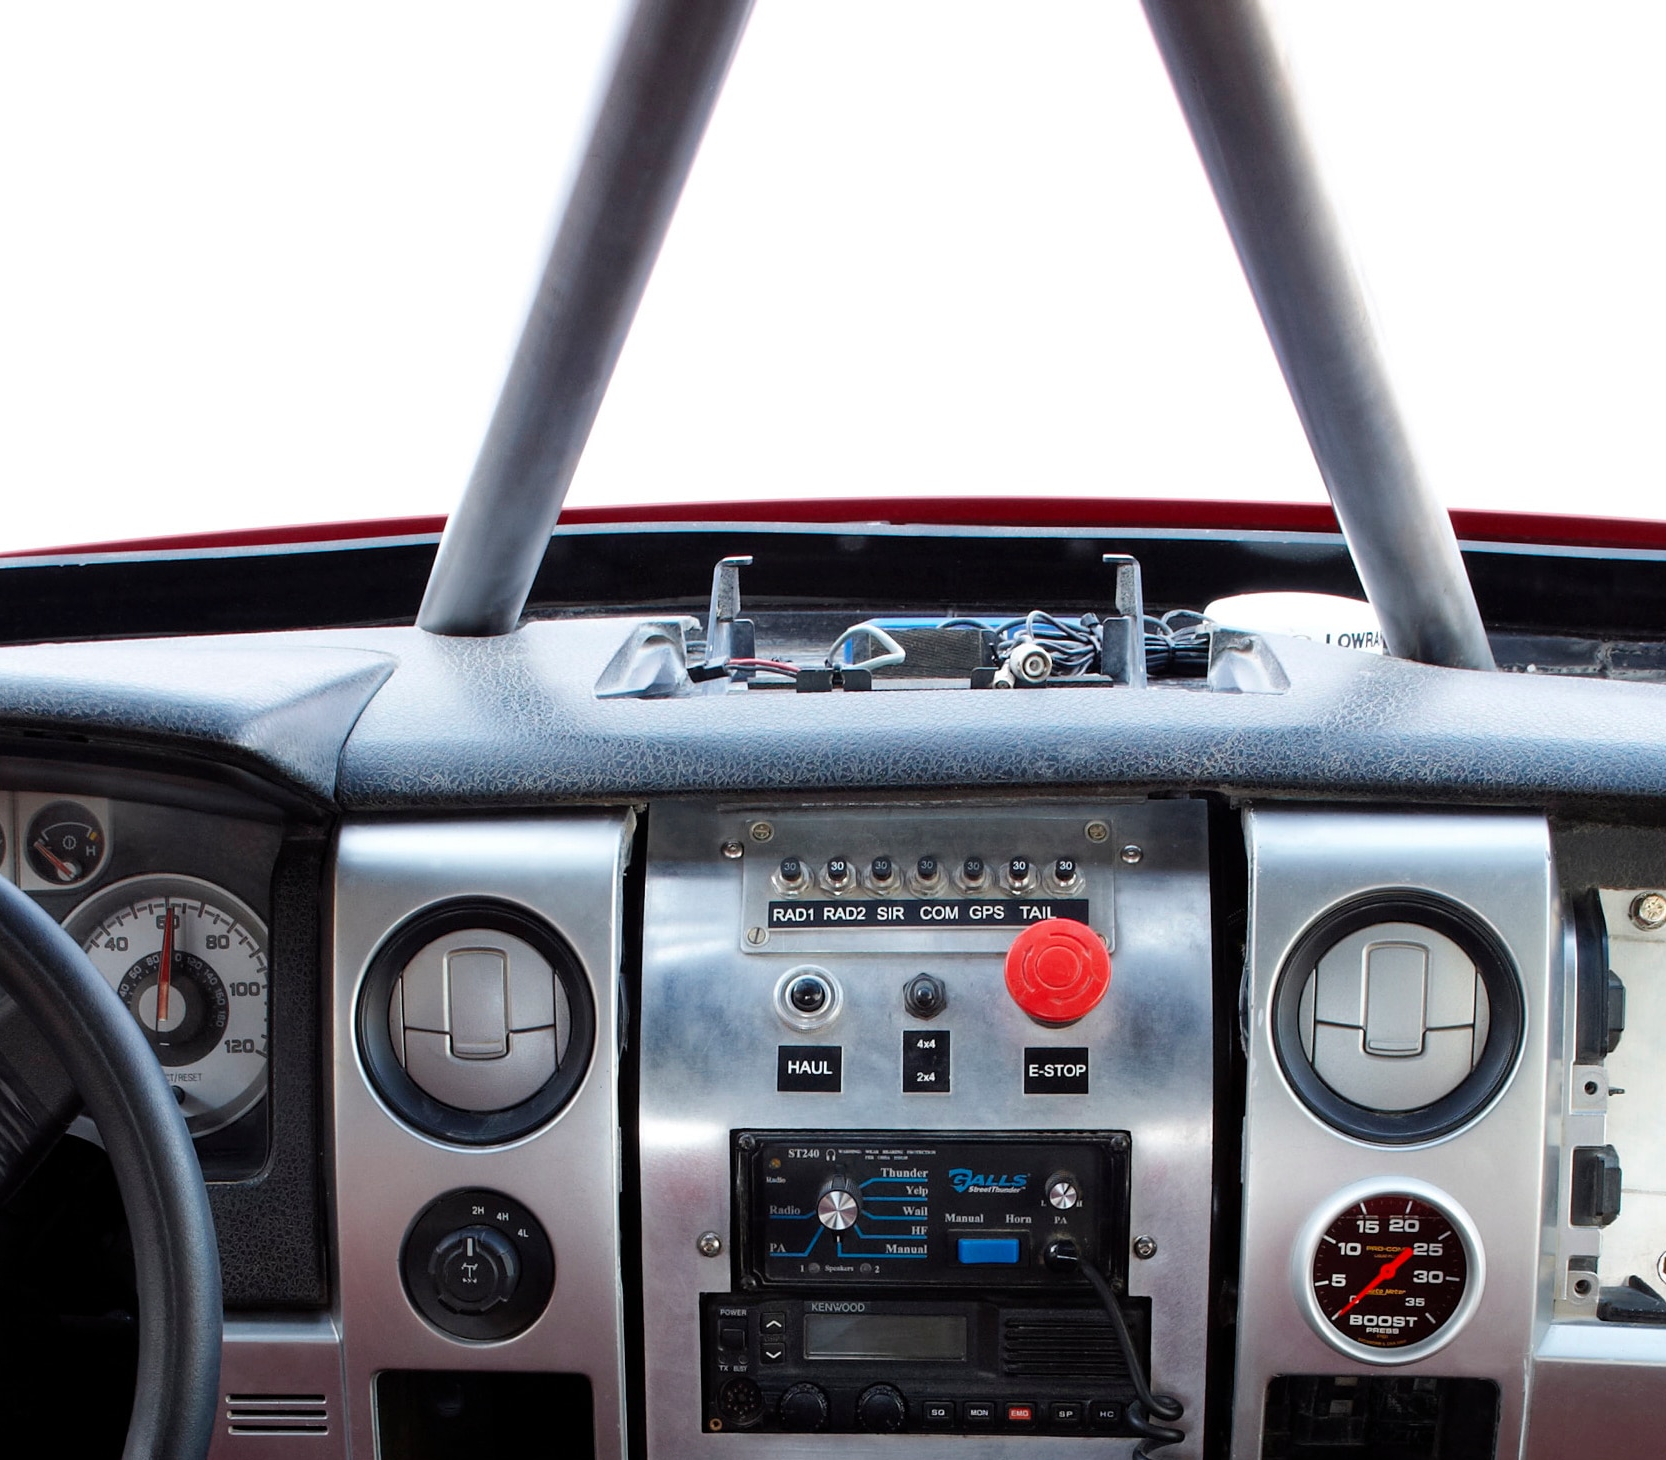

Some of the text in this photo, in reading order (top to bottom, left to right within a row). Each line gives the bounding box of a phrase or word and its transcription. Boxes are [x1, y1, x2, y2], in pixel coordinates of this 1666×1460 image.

[830, 861, 844, 871] 30
[1013, 861, 1026, 870] 30
[1059, 861, 1073, 870] 30
[773, 905, 1057, 922] RAD1 RAD2 SIR COM GPS TAIL
[104, 936, 129, 951] 40
[206, 934, 230, 950] 80
[229, 982, 260, 996] 100
[224, 1039, 255, 1053] 120
[917, 1039, 936, 1049] 4x4
[787, 1060, 833, 1075] HAUL
[1028, 1063, 1087, 1077] E-STOP
[917, 1072, 935, 1082] 2x4
[788, 1149, 820, 1158] ST240
[881, 1168, 929, 1178] Thunder
[906, 1185, 929, 1197] Yelp
[472, 1206, 485, 1215] 2H
[769, 1205, 801, 1215] Radio
[903, 1206, 928, 1216] Wail
[496, 1212, 509, 1221] 4H
[945, 1213, 984, 1223] Manual
[1005, 1214, 1032, 1224] Horn
[1054, 1216, 1067, 1224] PA
[911, 1226, 928, 1235] HF
[1356, 1220, 1380, 1234] 15
[1389, 1219, 1420, 1232] 20
[517, 1228, 529, 1238] 4L
[770, 1243, 787, 1253] PA
[885, 1244, 928, 1254] Manual
[1337, 1242, 1362, 1256] 10
[1413, 1242, 1443, 1256] 25
[1331, 1274, 1346, 1287] 5
[1413, 1271, 1444, 1284] 30
[811, 1302, 866, 1312] KENWOOD
[1405, 1298, 1425, 1307] 35
[1349, 1315, 1418, 1327] BOOST
[1058, 1410, 1073, 1418] SP
